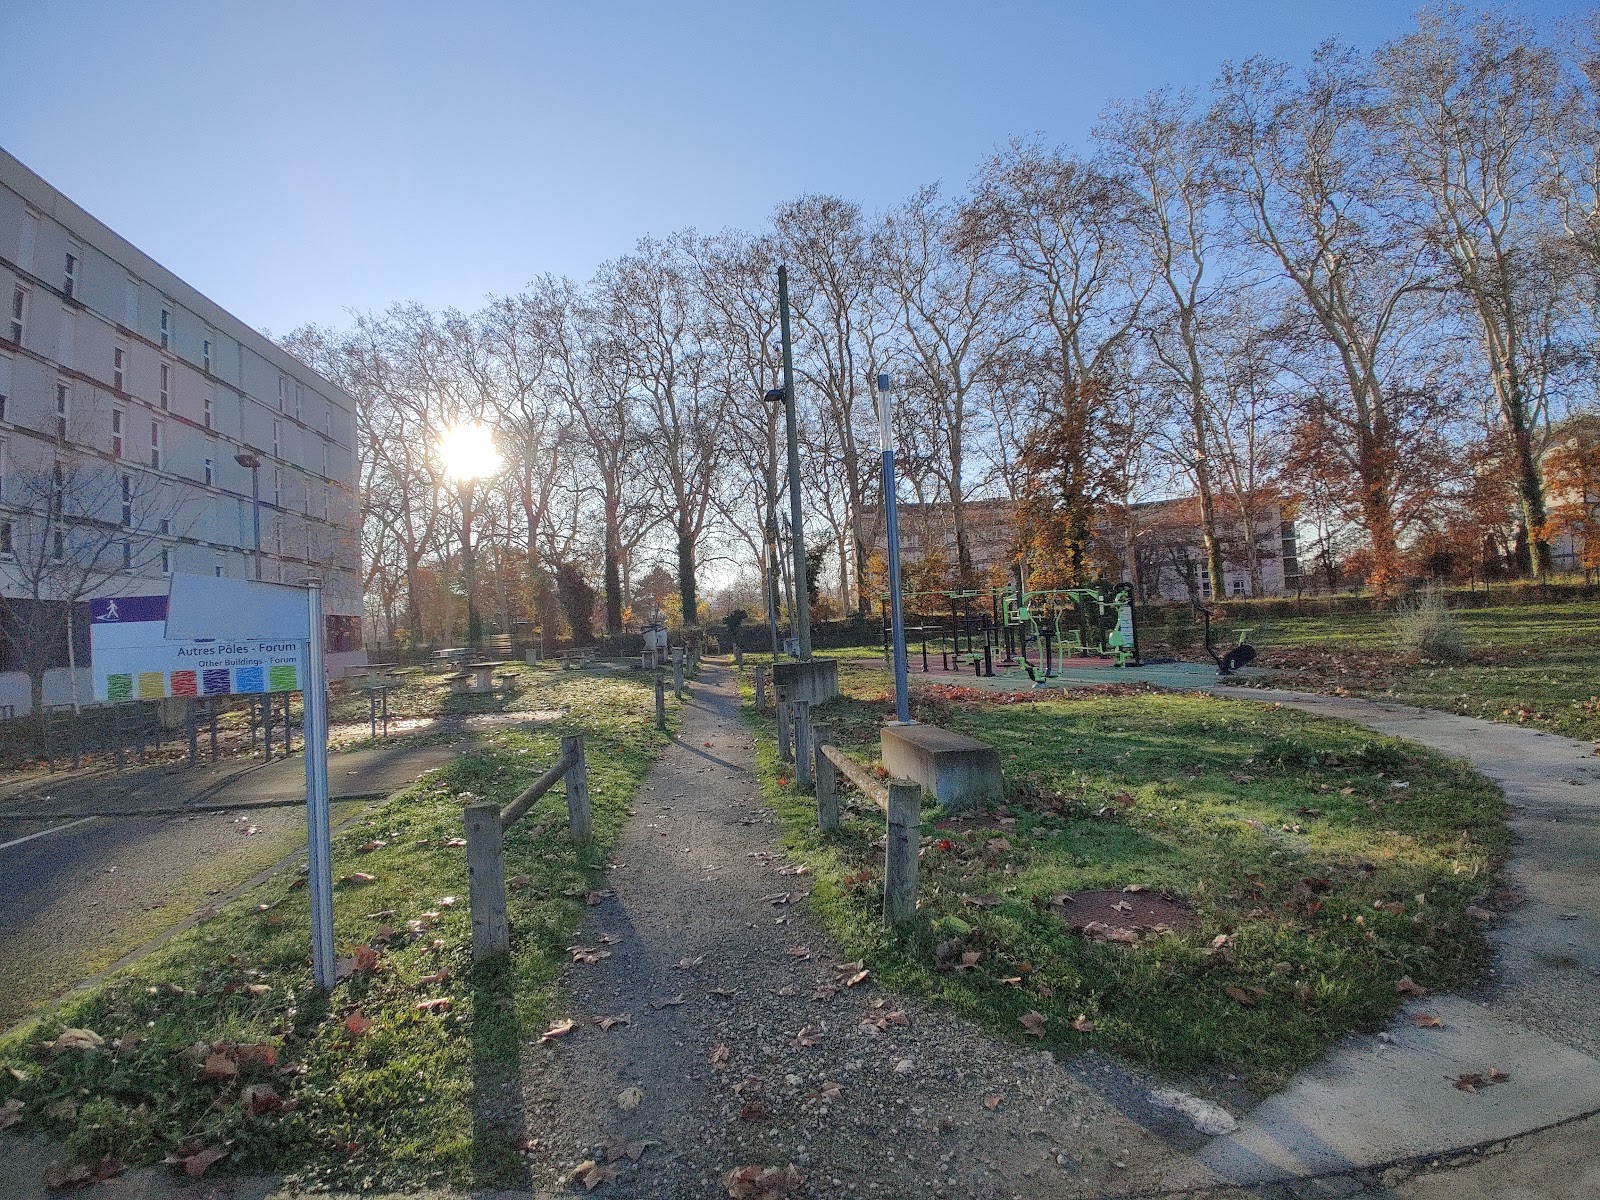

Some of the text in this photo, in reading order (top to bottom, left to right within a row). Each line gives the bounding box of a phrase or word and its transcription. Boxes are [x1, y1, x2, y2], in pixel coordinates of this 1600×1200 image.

[177, 647, 215, 656] Autres
[218, 644, 249, 655] Pôles
[259, 643, 296, 652] Forum
[198, 660, 222, 668] Other
[225, 658, 263, 667] Buildings
[270, 656, 297, 664] Forum
